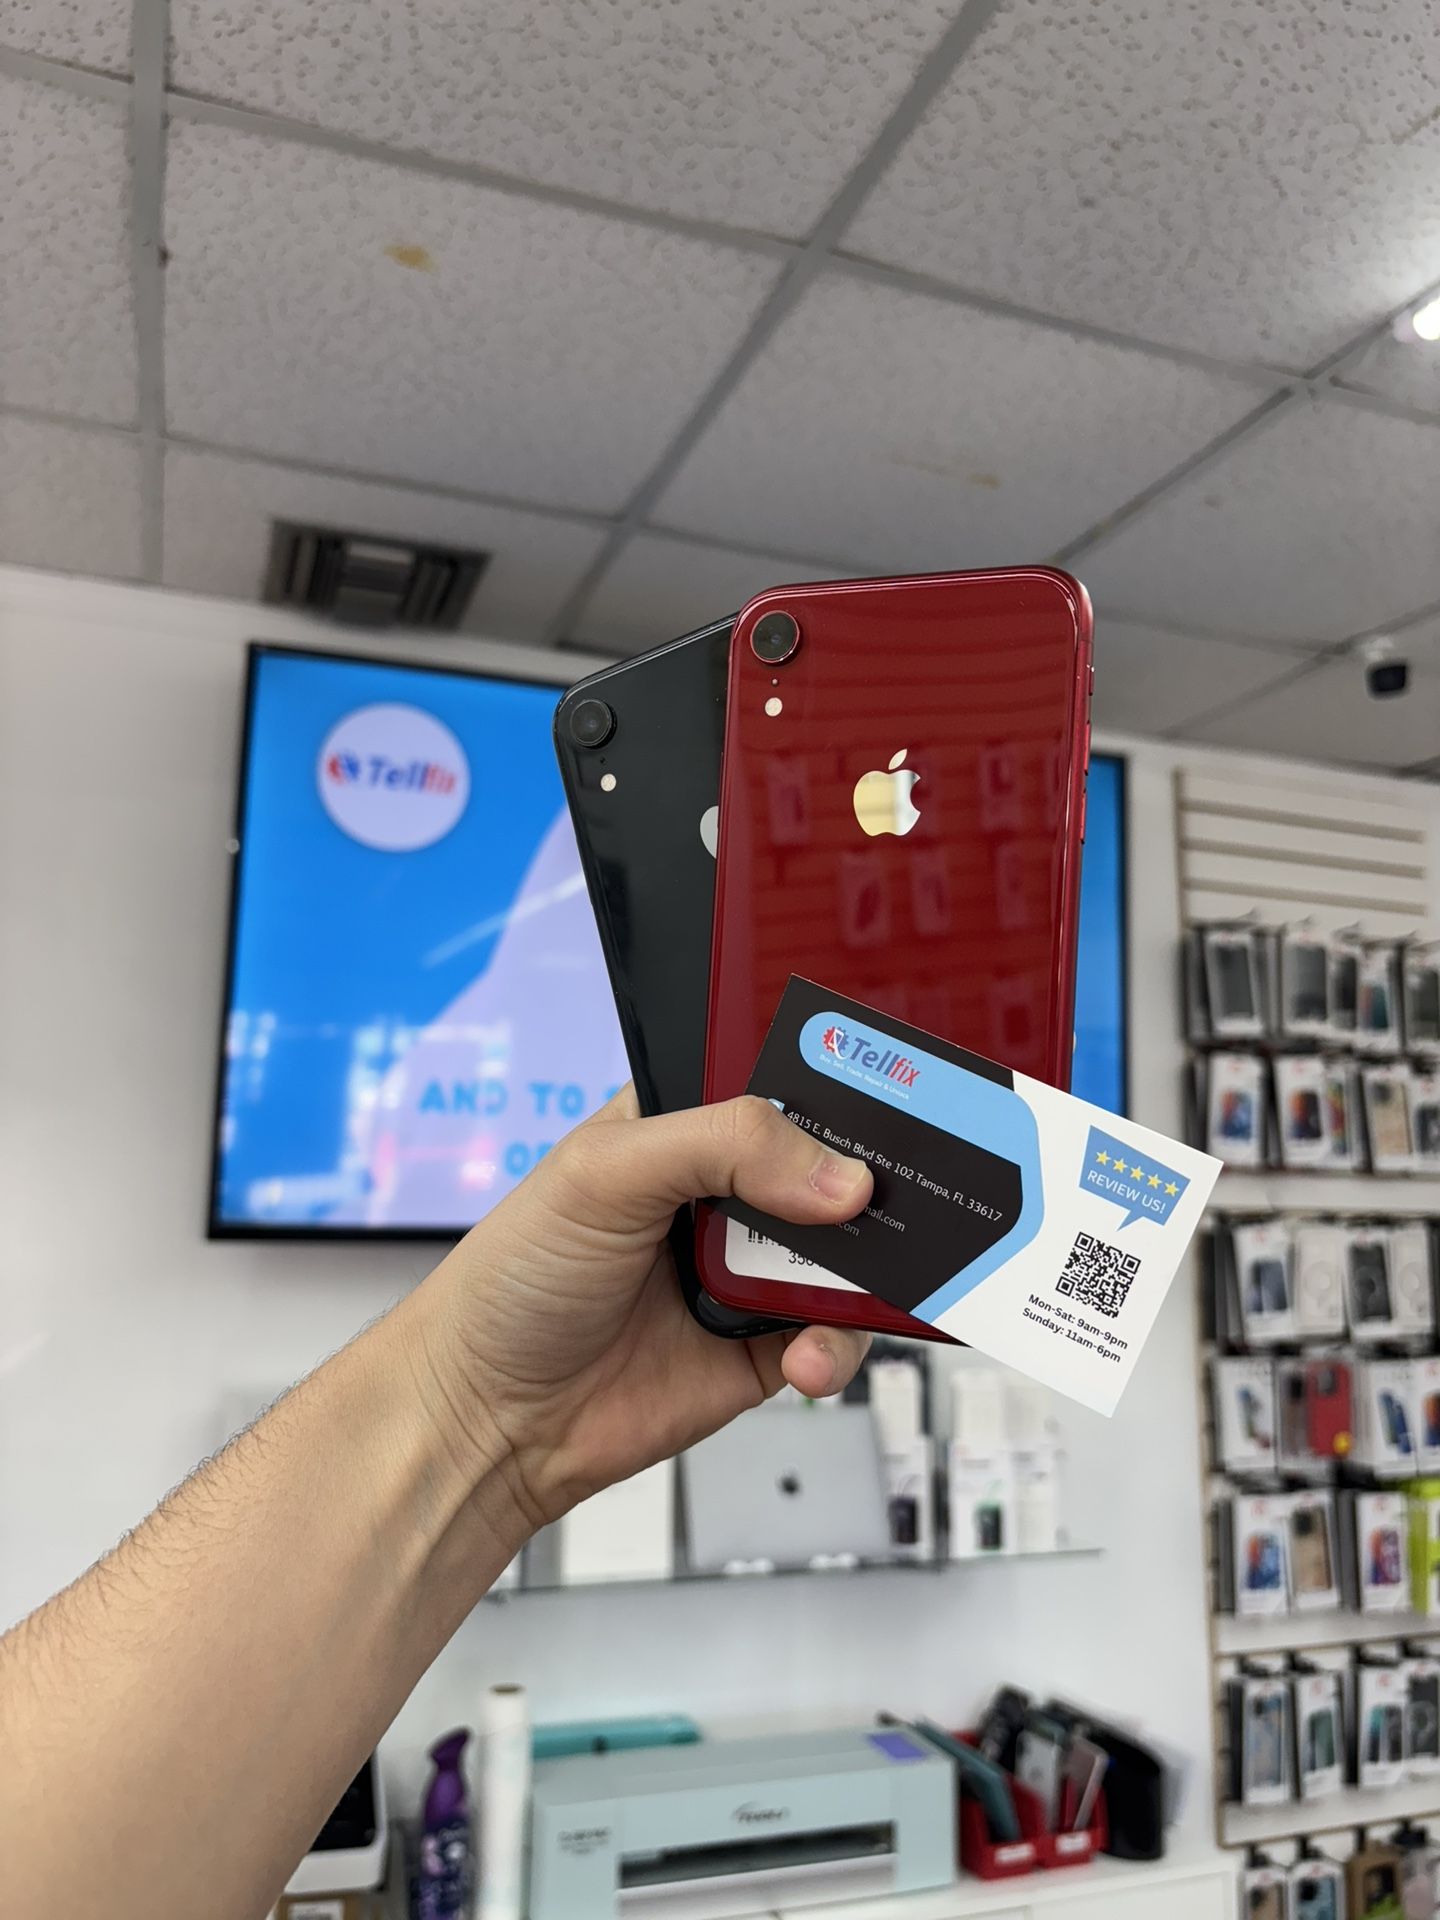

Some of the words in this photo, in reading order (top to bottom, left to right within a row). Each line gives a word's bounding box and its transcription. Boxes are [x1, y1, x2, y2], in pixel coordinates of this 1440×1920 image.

[850, 1037, 920, 1088] Tellfix
[529, 1080, 585, 1118] TO
[787, 1111, 812, 1129] 4815
[812, 1122, 821, 1135] E.
[823, 1128, 852, 1149] Busch
[852, 1143, 875, 1161] Blvd
[874, 1153, 893, 1170] Ste
[894, 1162, 915, 1181] 102
[916, 1173, 950, 1200] Tampa,
[952, 1191, 965, 1206] FL
[966, 1198, 1003, 1222] 33617
[1087, 1170, 1141, 1202] REVIEW
[1141, 1194, 1167, 1214] US!
[1022, 1307, 1065, 1335] Sunday:
[1065, 1328, 1122, 1363] 11am-6pm
[1028, 1294, 1076, 1324] Mon-Sat:
[1076, 1318, 1129, 1350] 9am-9pm
